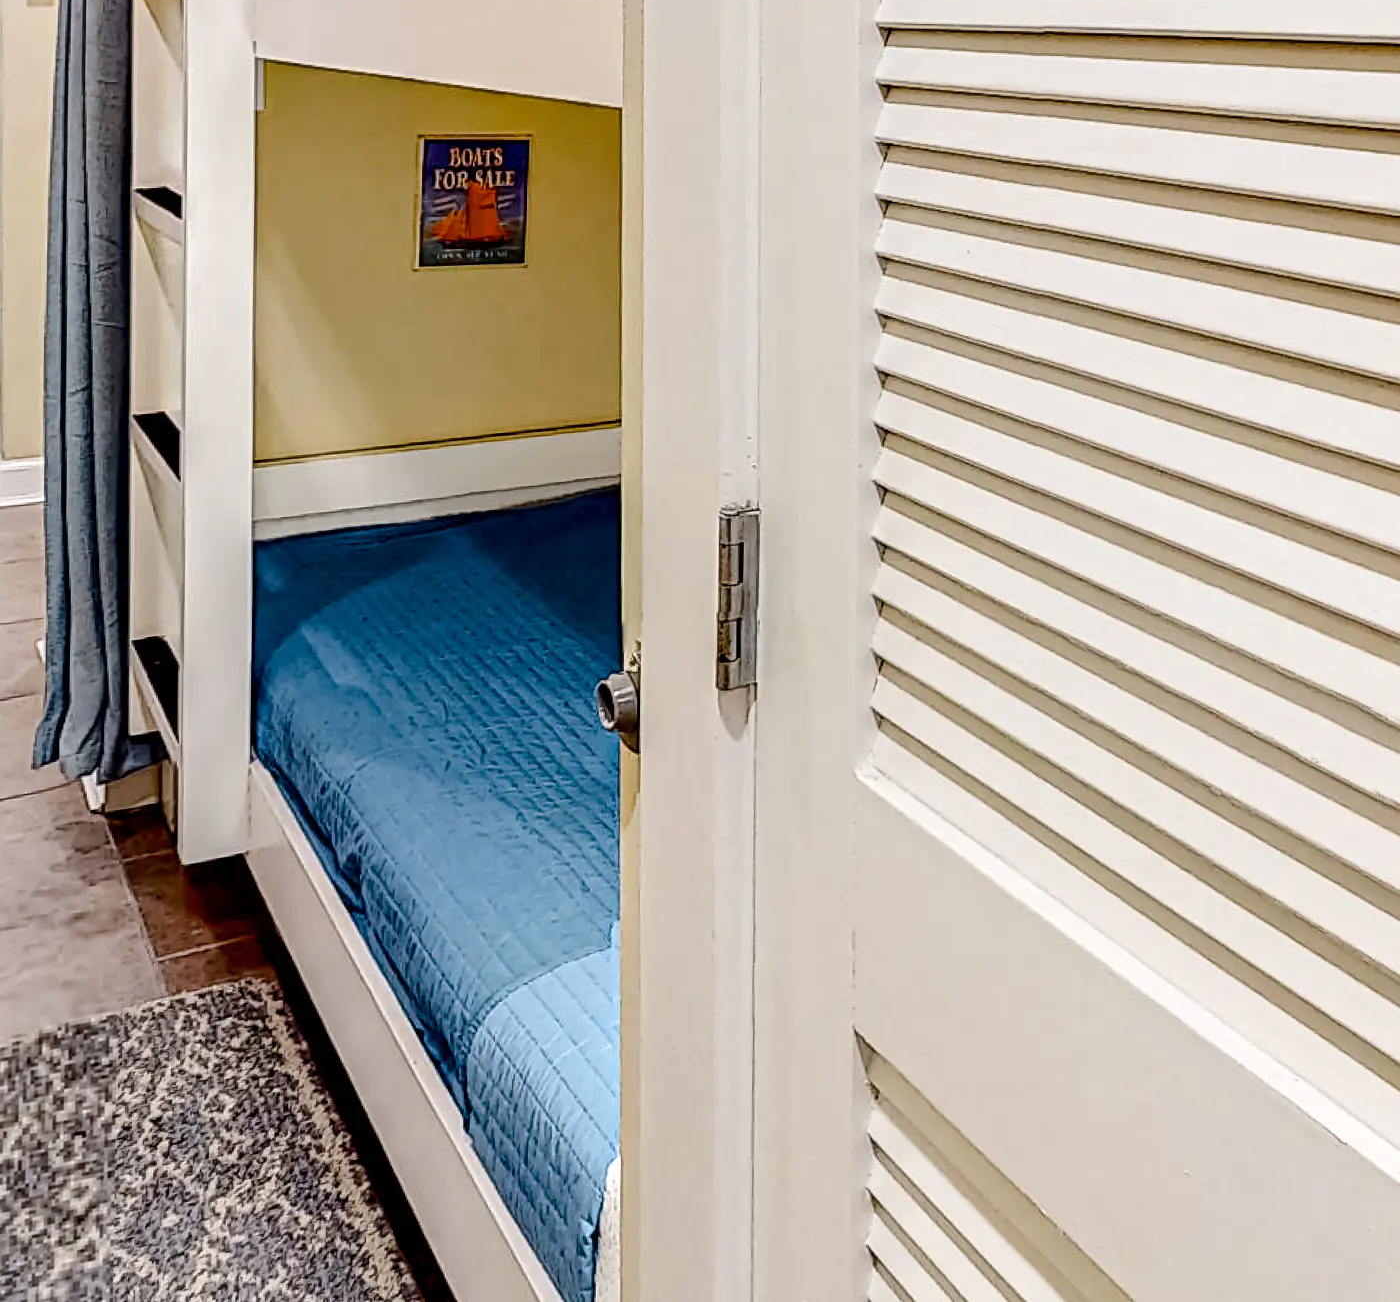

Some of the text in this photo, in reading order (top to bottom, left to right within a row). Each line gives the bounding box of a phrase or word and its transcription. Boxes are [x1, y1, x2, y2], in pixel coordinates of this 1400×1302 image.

[449, 147, 503, 167] BOATS
[433, 168, 515, 190] FOR SALE
